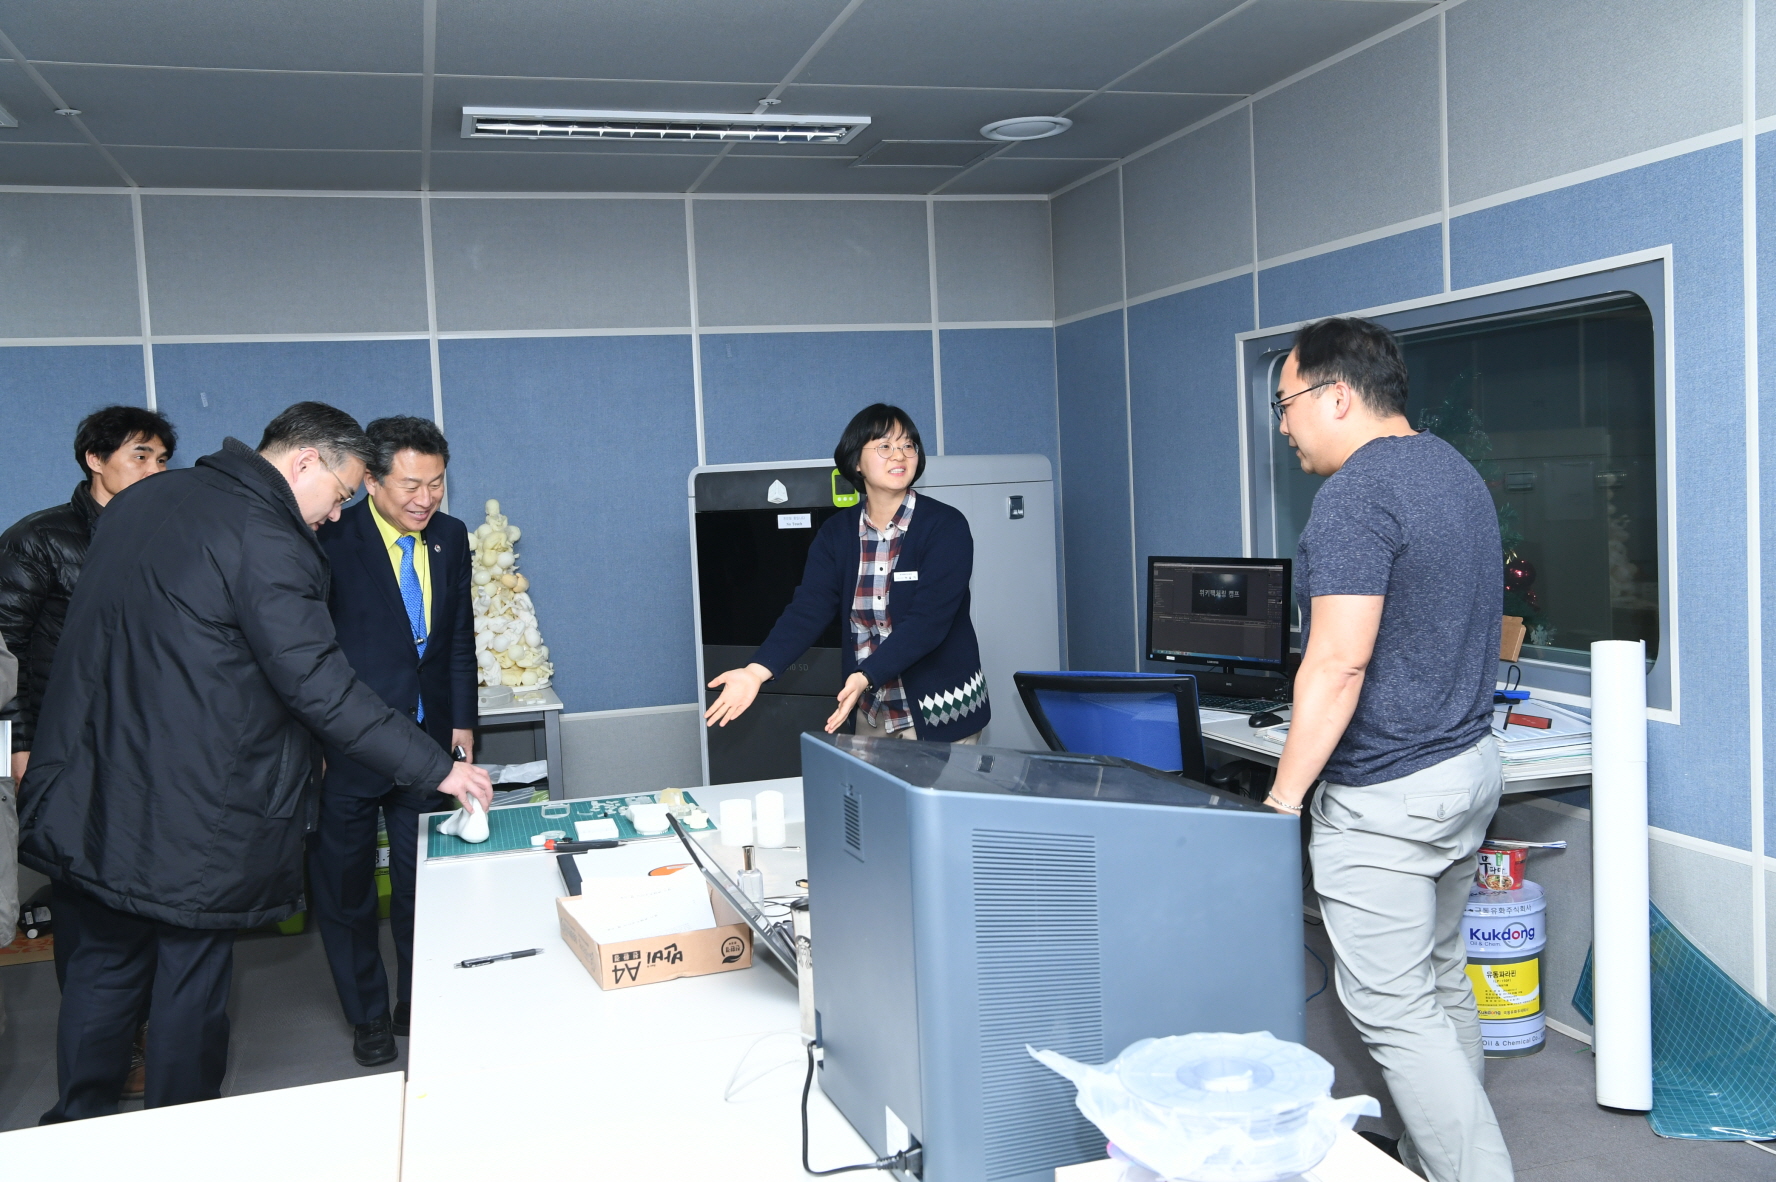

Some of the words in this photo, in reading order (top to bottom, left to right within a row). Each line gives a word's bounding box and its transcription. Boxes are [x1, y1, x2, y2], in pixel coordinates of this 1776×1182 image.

[1228, 590, 1240, 598] 캠프
[798, 663, 809, 671] SD
[1469, 927, 1535, 941] Kukdong
[647, 943, 683, 965] 반비
[612, 961, 642, 985] A4
[1502, 1038, 1531, 1046] Chemical
